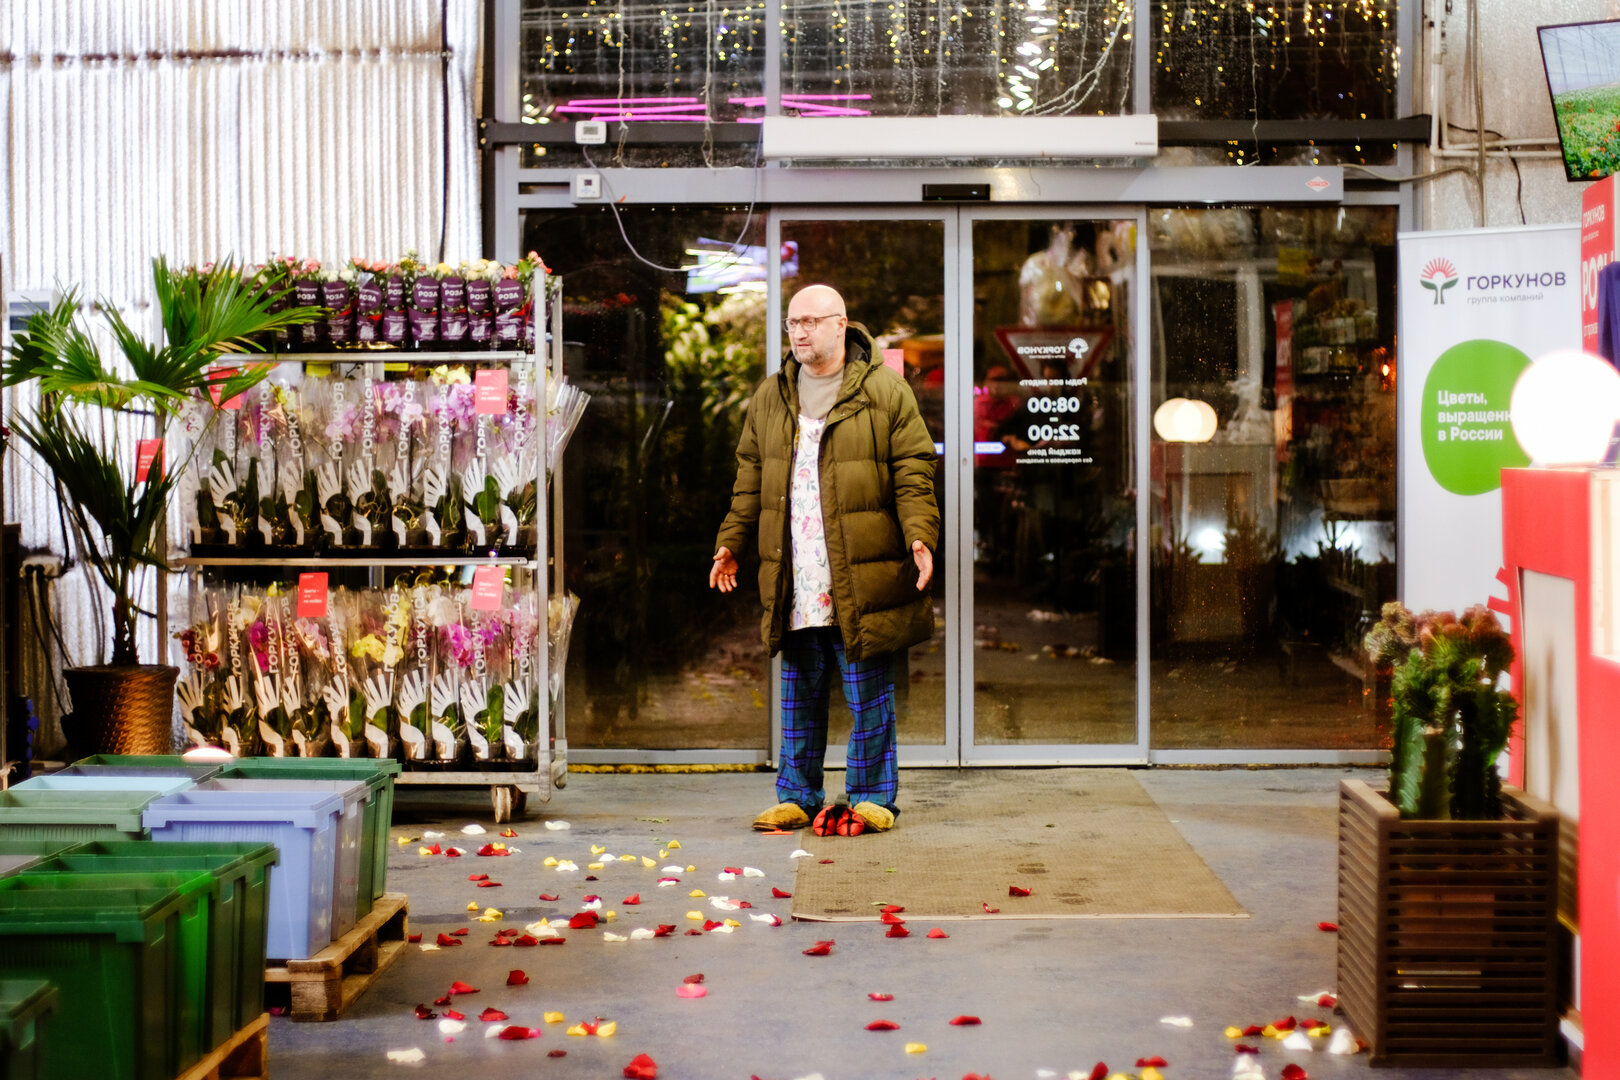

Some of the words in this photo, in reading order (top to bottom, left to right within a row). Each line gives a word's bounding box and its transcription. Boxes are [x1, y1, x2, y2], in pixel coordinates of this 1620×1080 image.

[498, 292, 519, 300] РОЗА
[1467, 272, 1566, 290] ГОРКУНОВ
[1467, 295, 1497, 305] группа
[1500, 292, 1544, 303] компаний
[1438, 390, 1487, 406] Цветы,
[260, 380, 271, 459] ГОРКУНОВ
[362, 378, 374, 457] ГОРКУНОВ
[398, 380, 416, 459] ГОРКОВ
[1438, 409, 1511, 424] выращенн
[477, 414, 486, 457] ГОРК
[1438, 429, 1446, 441] в
[1450, 426, 1503, 441] России
[384, 593, 400, 672] ГКУНОВ
[471, 610, 486, 677] ГОРКУНО
